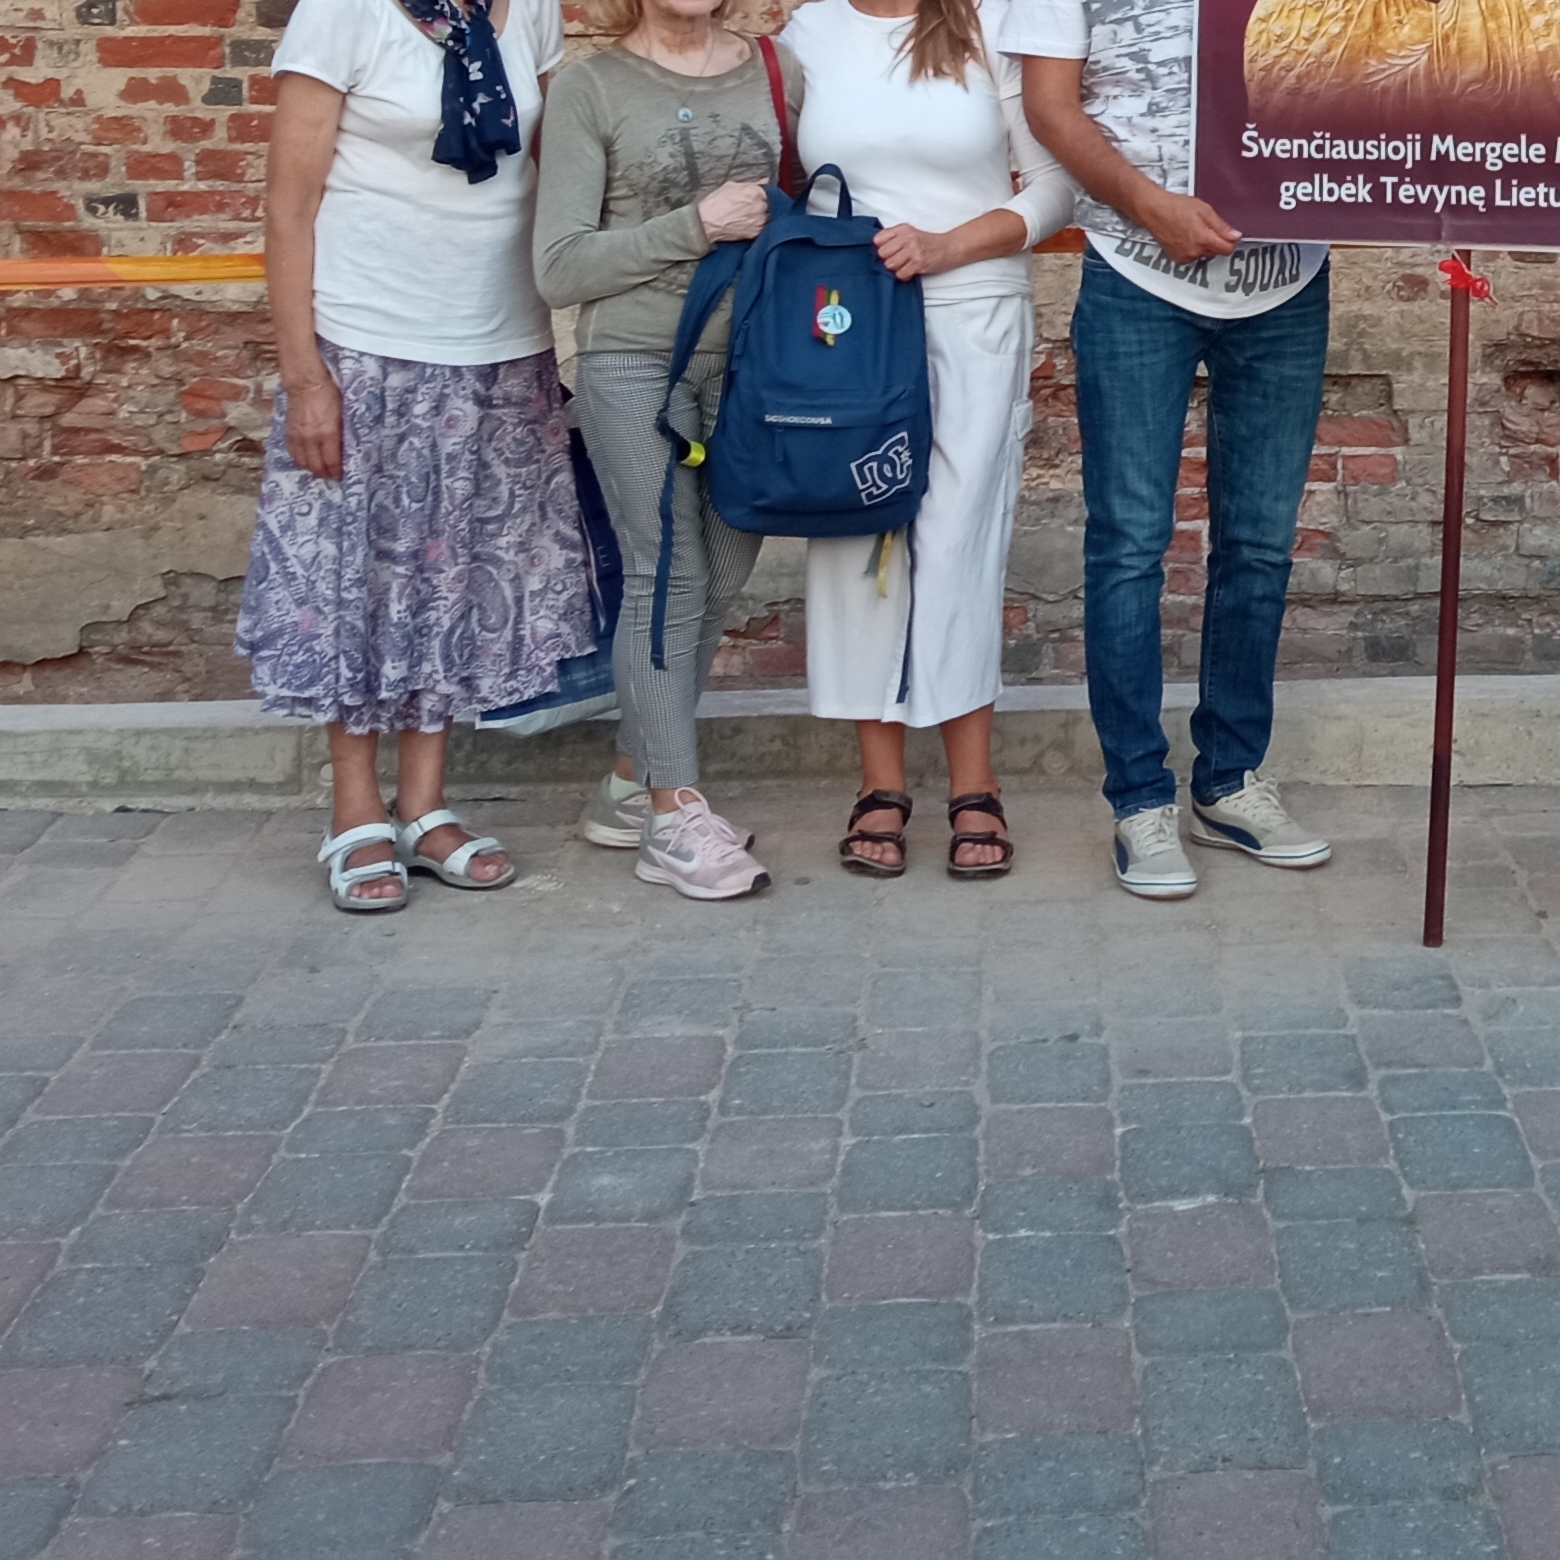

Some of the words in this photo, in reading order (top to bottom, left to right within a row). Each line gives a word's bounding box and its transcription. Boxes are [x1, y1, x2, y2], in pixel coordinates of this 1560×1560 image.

[1241, 123, 1422, 170] Švenčiausioji
[1430, 133, 1546, 171] Mergele
[1279, 173, 1373, 210] gelbėk
[1379, 176, 1487, 213] Tėvynę
[1224, 242, 1300, 296] SQUAD
